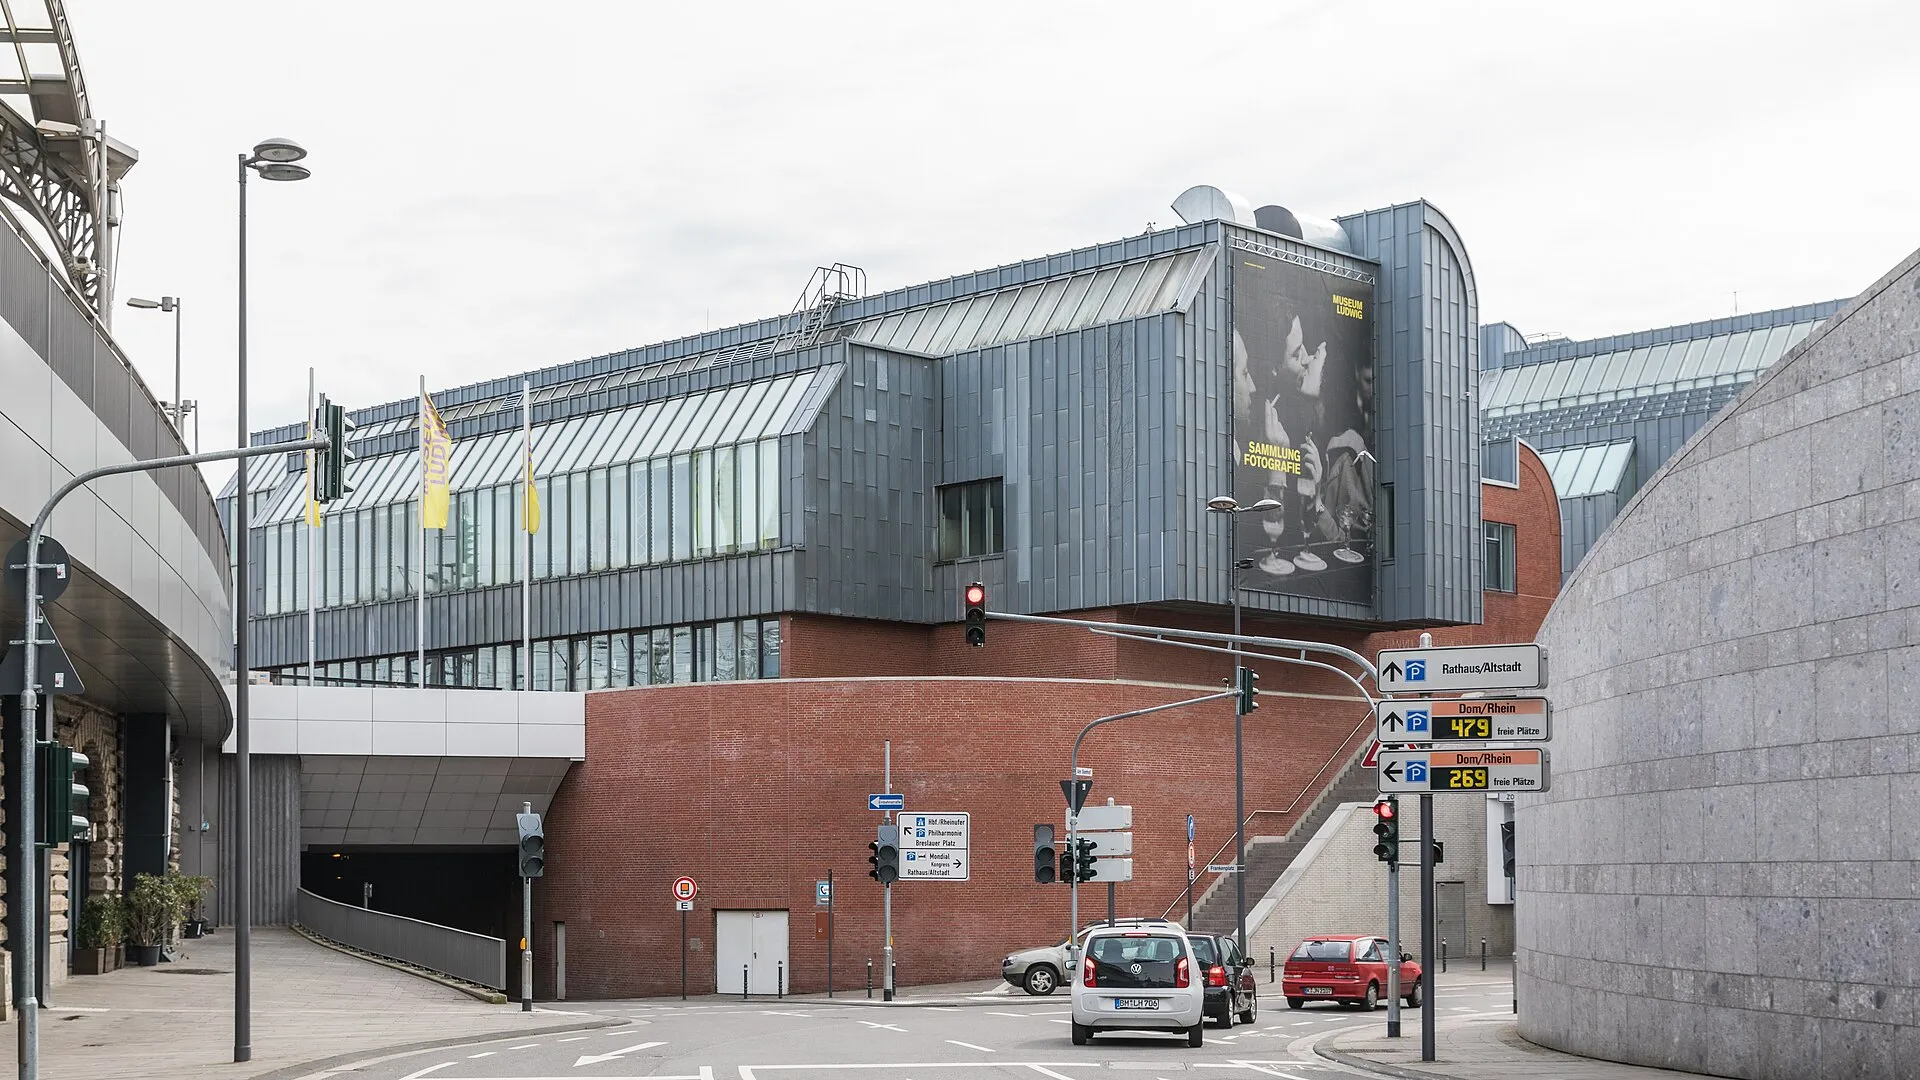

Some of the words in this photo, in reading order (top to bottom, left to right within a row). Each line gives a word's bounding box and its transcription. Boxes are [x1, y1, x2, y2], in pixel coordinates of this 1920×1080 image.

[1333, 294, 1363, 310] MUSEUM
[1336, 305, 1363, 320] LUDWIG
[1248, 441, 1301, 463] SAMMLUNG
[1244, 453, 1301, 475] FOTOGRAFIE
[1442, 662, 1522, 675] Rathaus/Altstadt
[1459, 703, 1516, 714] Dom/Rhein
[1451, 718, 1489, 737] 479
[1497, 726, 1514, 736] freie
[1517, 725, 1540, 736] Plätze
[1456, 753, 1512, 765] Dom/Rhein
[1450, 769, 1486, 788] 269
[1493, 777, 1511, 786] freie
[1513, 776, 1535, 786] Plätze
